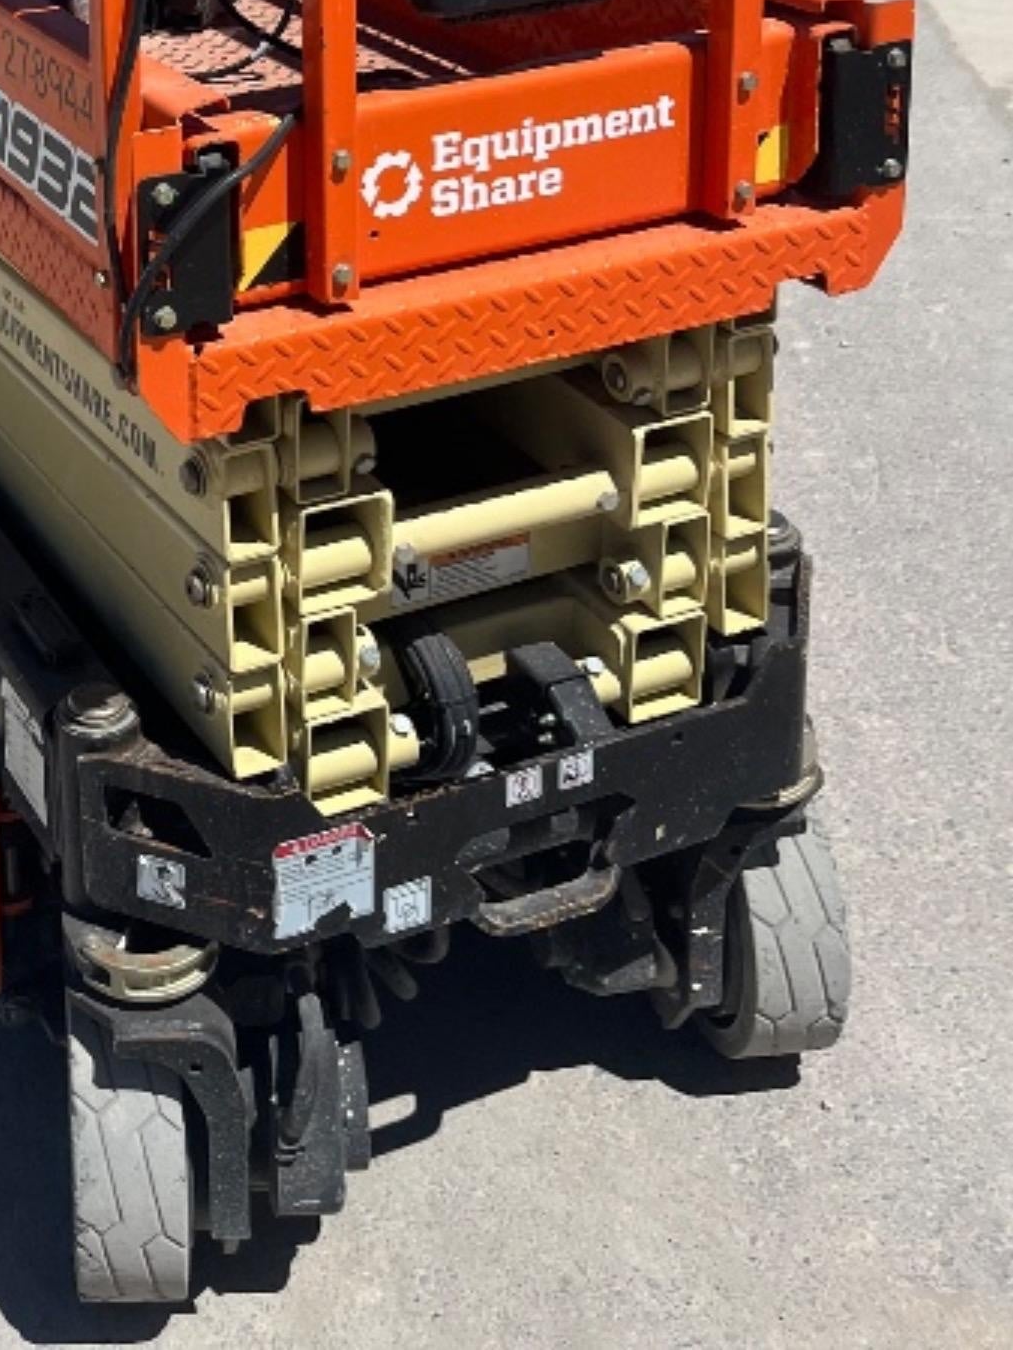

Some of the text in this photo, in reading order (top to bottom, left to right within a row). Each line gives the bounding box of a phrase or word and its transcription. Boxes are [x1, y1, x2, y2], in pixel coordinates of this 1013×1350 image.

[0, 28, 94, 123] 278944
[431, 95, 676, 173] Equipment
[430, 166, 564, 217] Share
